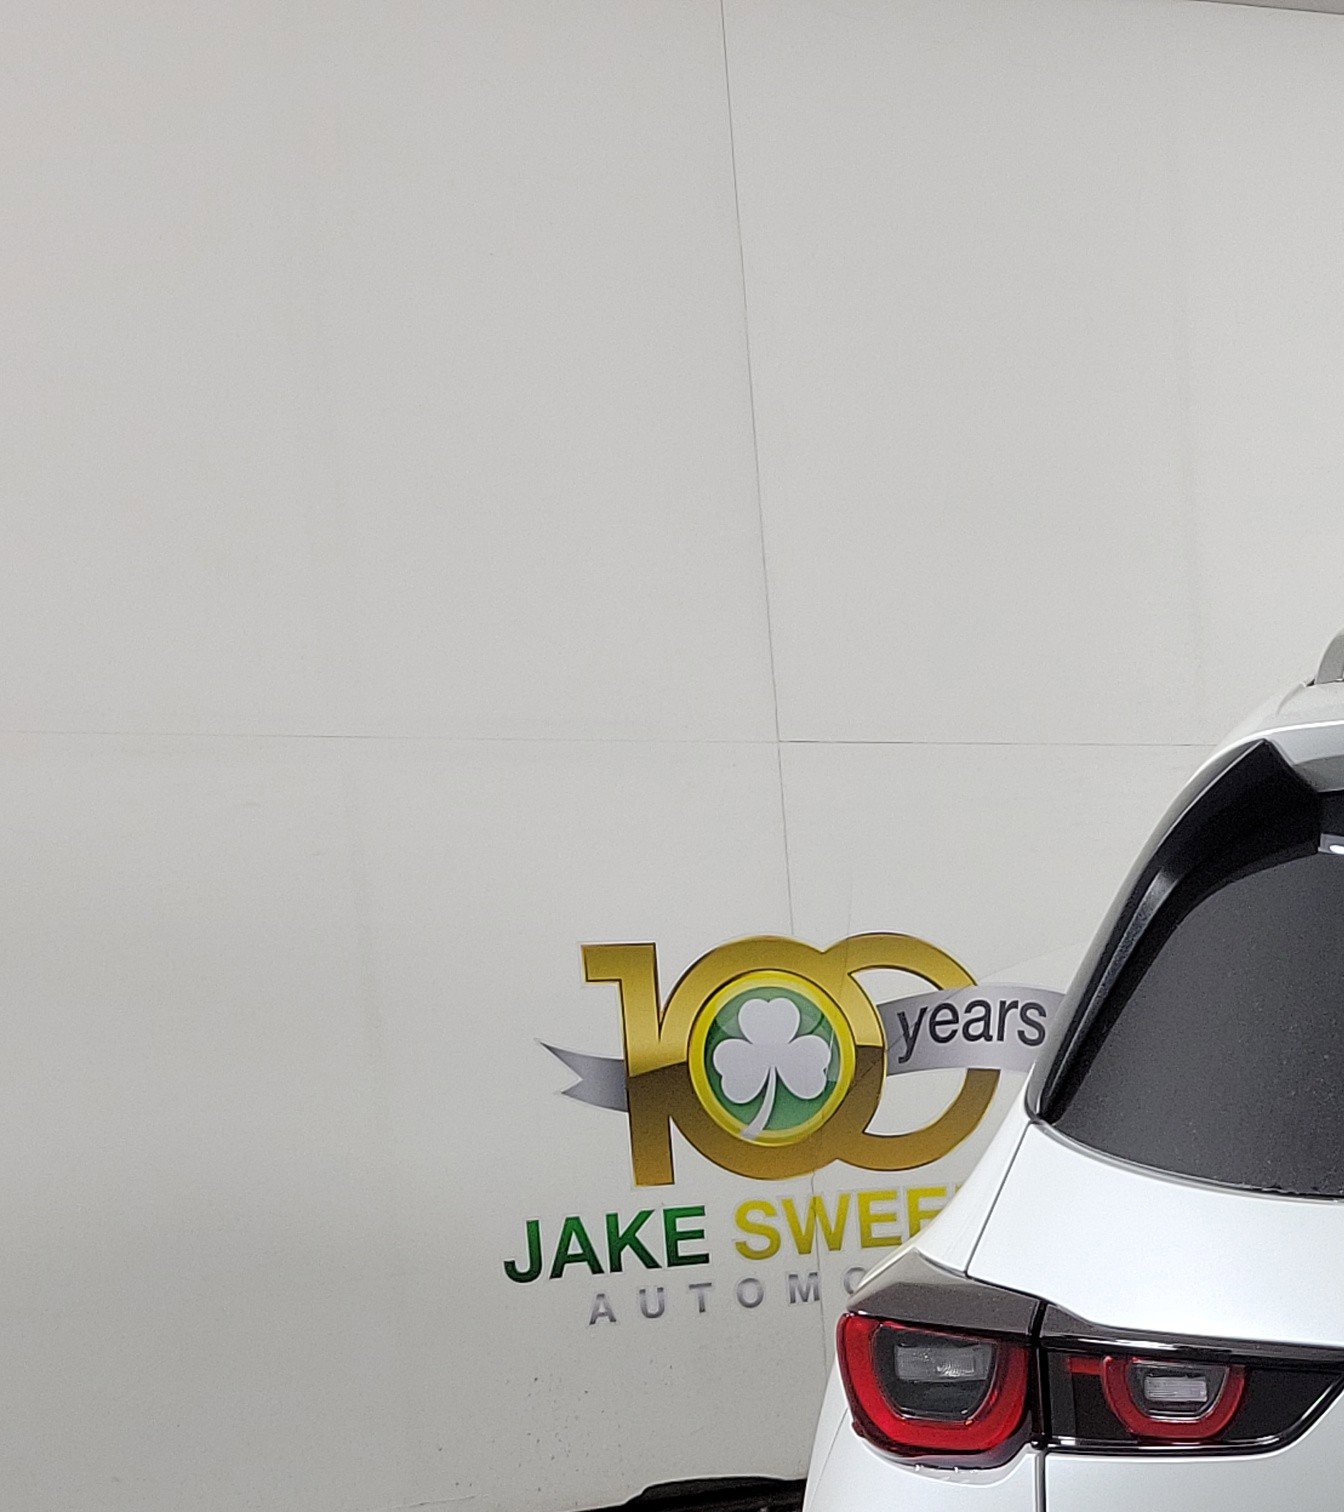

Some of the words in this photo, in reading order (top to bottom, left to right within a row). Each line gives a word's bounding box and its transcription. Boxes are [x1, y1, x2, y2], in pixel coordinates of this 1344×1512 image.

[581, 932, 1001, 1187] 100
[897, 997, 1048, 1062] years
[503, 1204, 711, 1284] JAKE
[733, 1184, 963, 1261] SWEE
